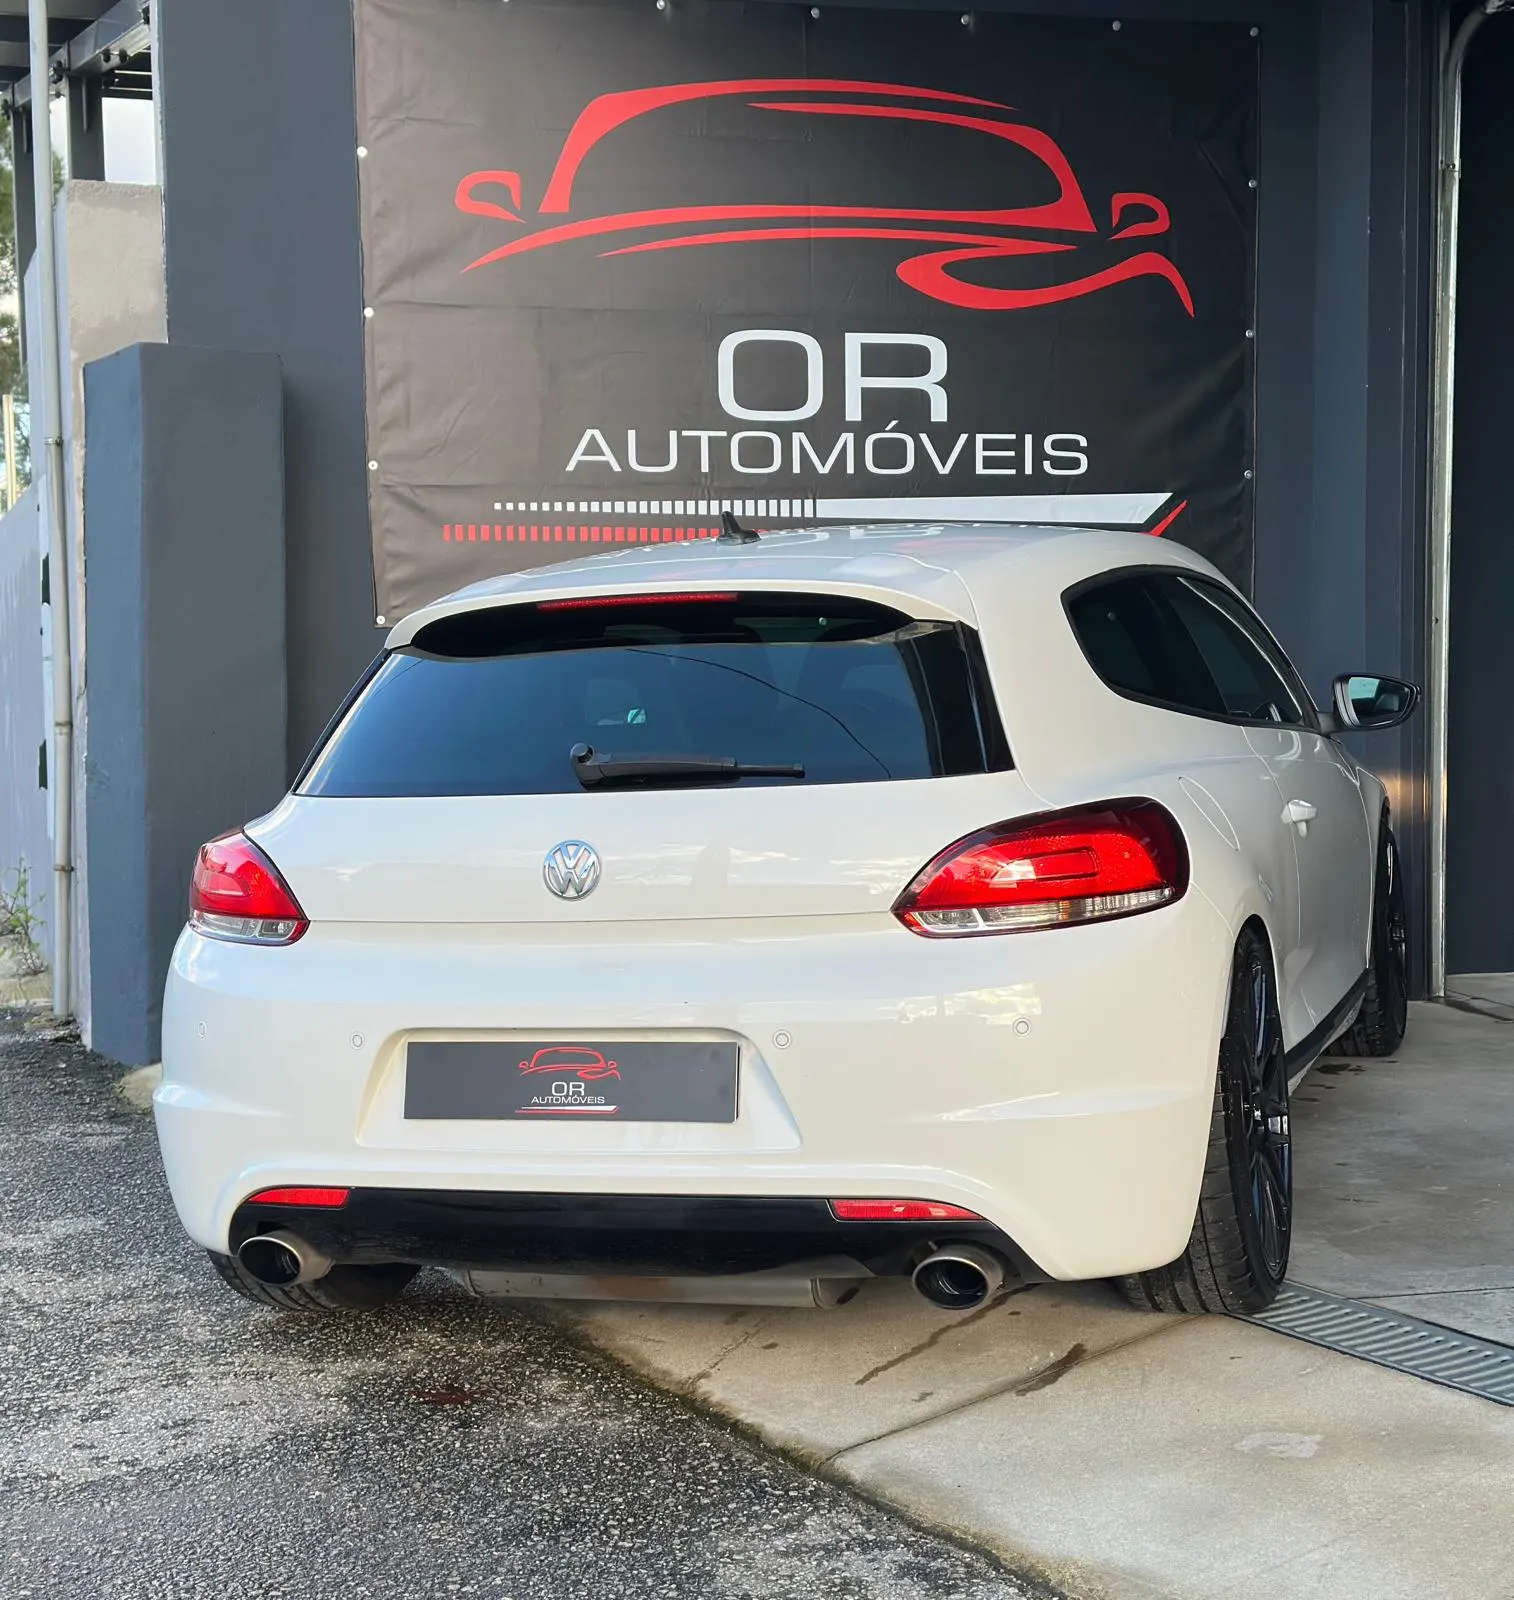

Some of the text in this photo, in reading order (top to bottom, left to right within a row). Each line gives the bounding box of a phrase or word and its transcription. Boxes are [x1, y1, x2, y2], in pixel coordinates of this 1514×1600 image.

[717, 329, 948, 422] OR
[565, 420, 1089, 475] AUTOMÓVEIS
[543, 840, 600, 900] VW
[531, 1095, 605, 1104] AUTOMÓVEIS
[551, 1081, 585, 1096] OR
